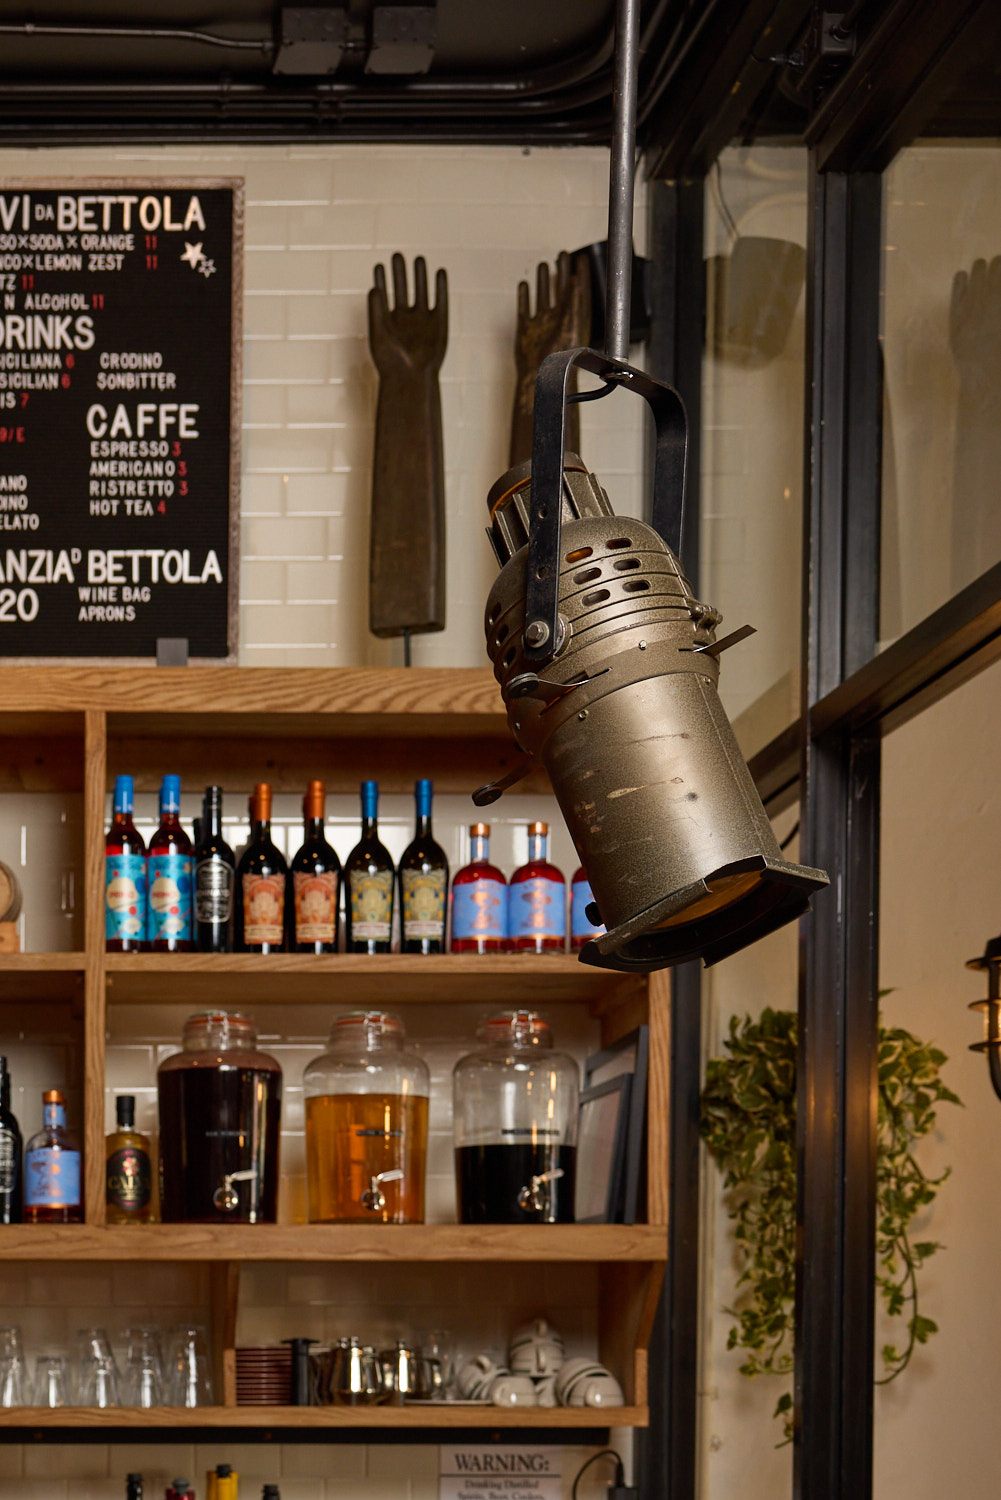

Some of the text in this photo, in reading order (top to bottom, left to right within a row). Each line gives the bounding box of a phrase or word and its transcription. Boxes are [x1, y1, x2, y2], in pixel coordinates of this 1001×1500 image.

[35, 204, 54, 220] DA
[58, 196, 205, 231] BETTOLA
[28, 234, 64, 250] SODA
[81, 234, 134, 251] ORANGE
[36, 254, 82, 270] LEMON
[88, 254, 124, 271] ZEST
[100, 352, 162, 369] CRODINO
[87, 404, 199, 438] CAFFE
[91, 441, 169, 457] ESPRESSO
[90, 460, 175, 477] AMERICANO
[90, 480, 174, 497] RISTRETTO
[90, 500, 119, 515] HOT
[124, 499, 153, 516] TEA
[87, 548, 222, 583] BETTOLA
[79, 587, 117, 602] WINE
[122, 587, 150, 602] BAG
[79, 606, 135, 621] APRONS
[454, 1454, 549, 1472] WARNING:
